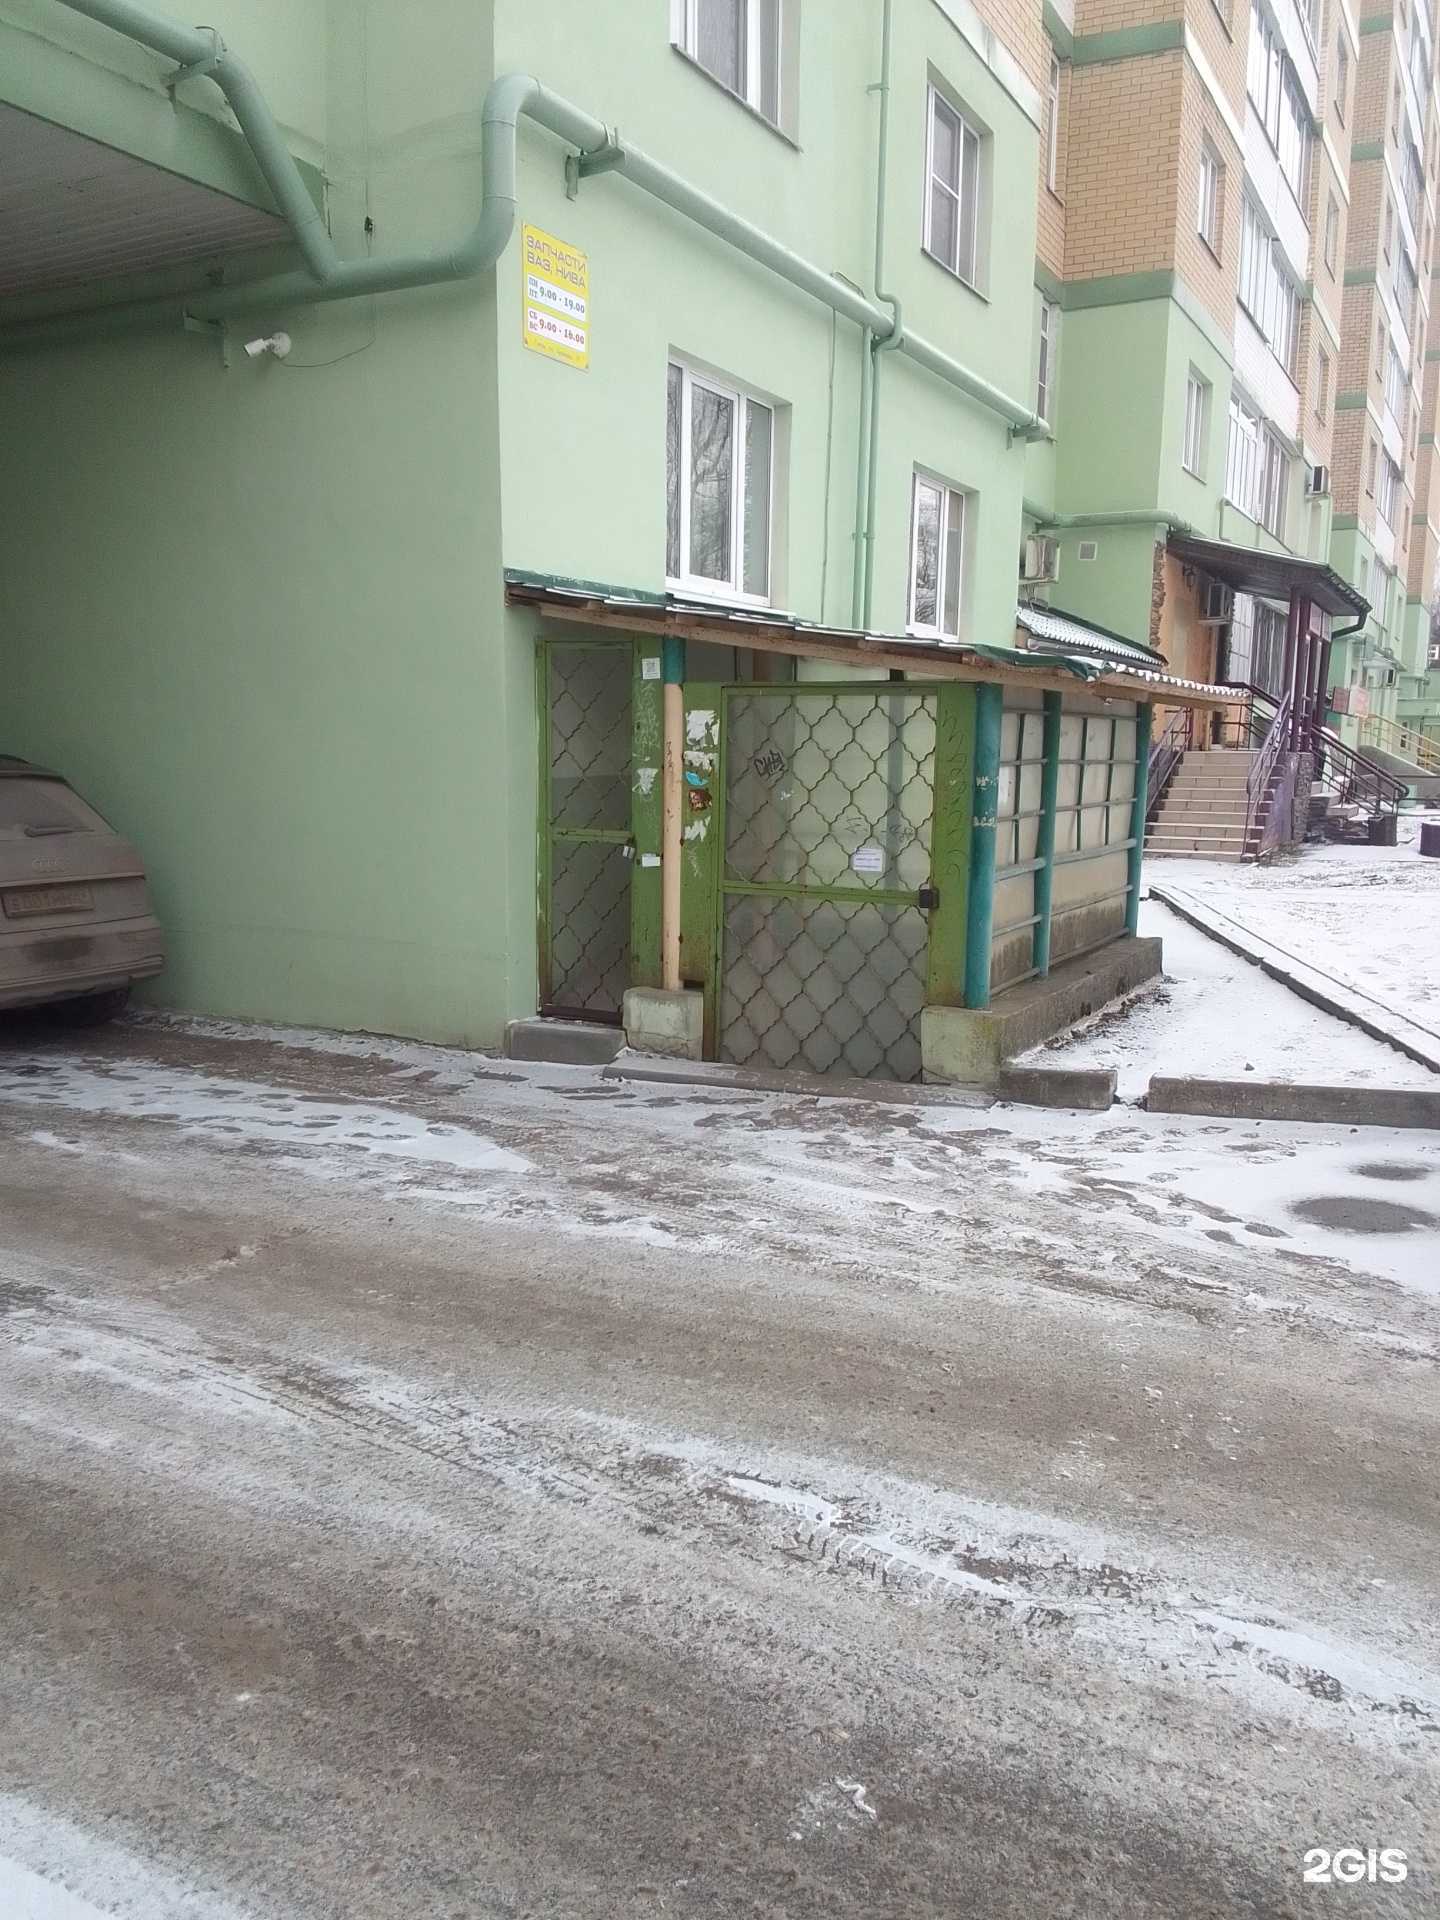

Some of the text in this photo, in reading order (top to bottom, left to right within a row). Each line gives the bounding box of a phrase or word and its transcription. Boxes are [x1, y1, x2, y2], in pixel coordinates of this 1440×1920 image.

[526, 235, 586, 273] ЗАПЧАСТИ
[555, 267, 586, 289] НИВА
[529, 288, 538, 298] ПТ
[539, 286, 557, 301] 9.00
[564, 298, 585, 314] 19.00
[529, 310, 538, 320] СБ
[529, 321, 538, 331] ВС
[539, 318, 557, 333] 9.00
